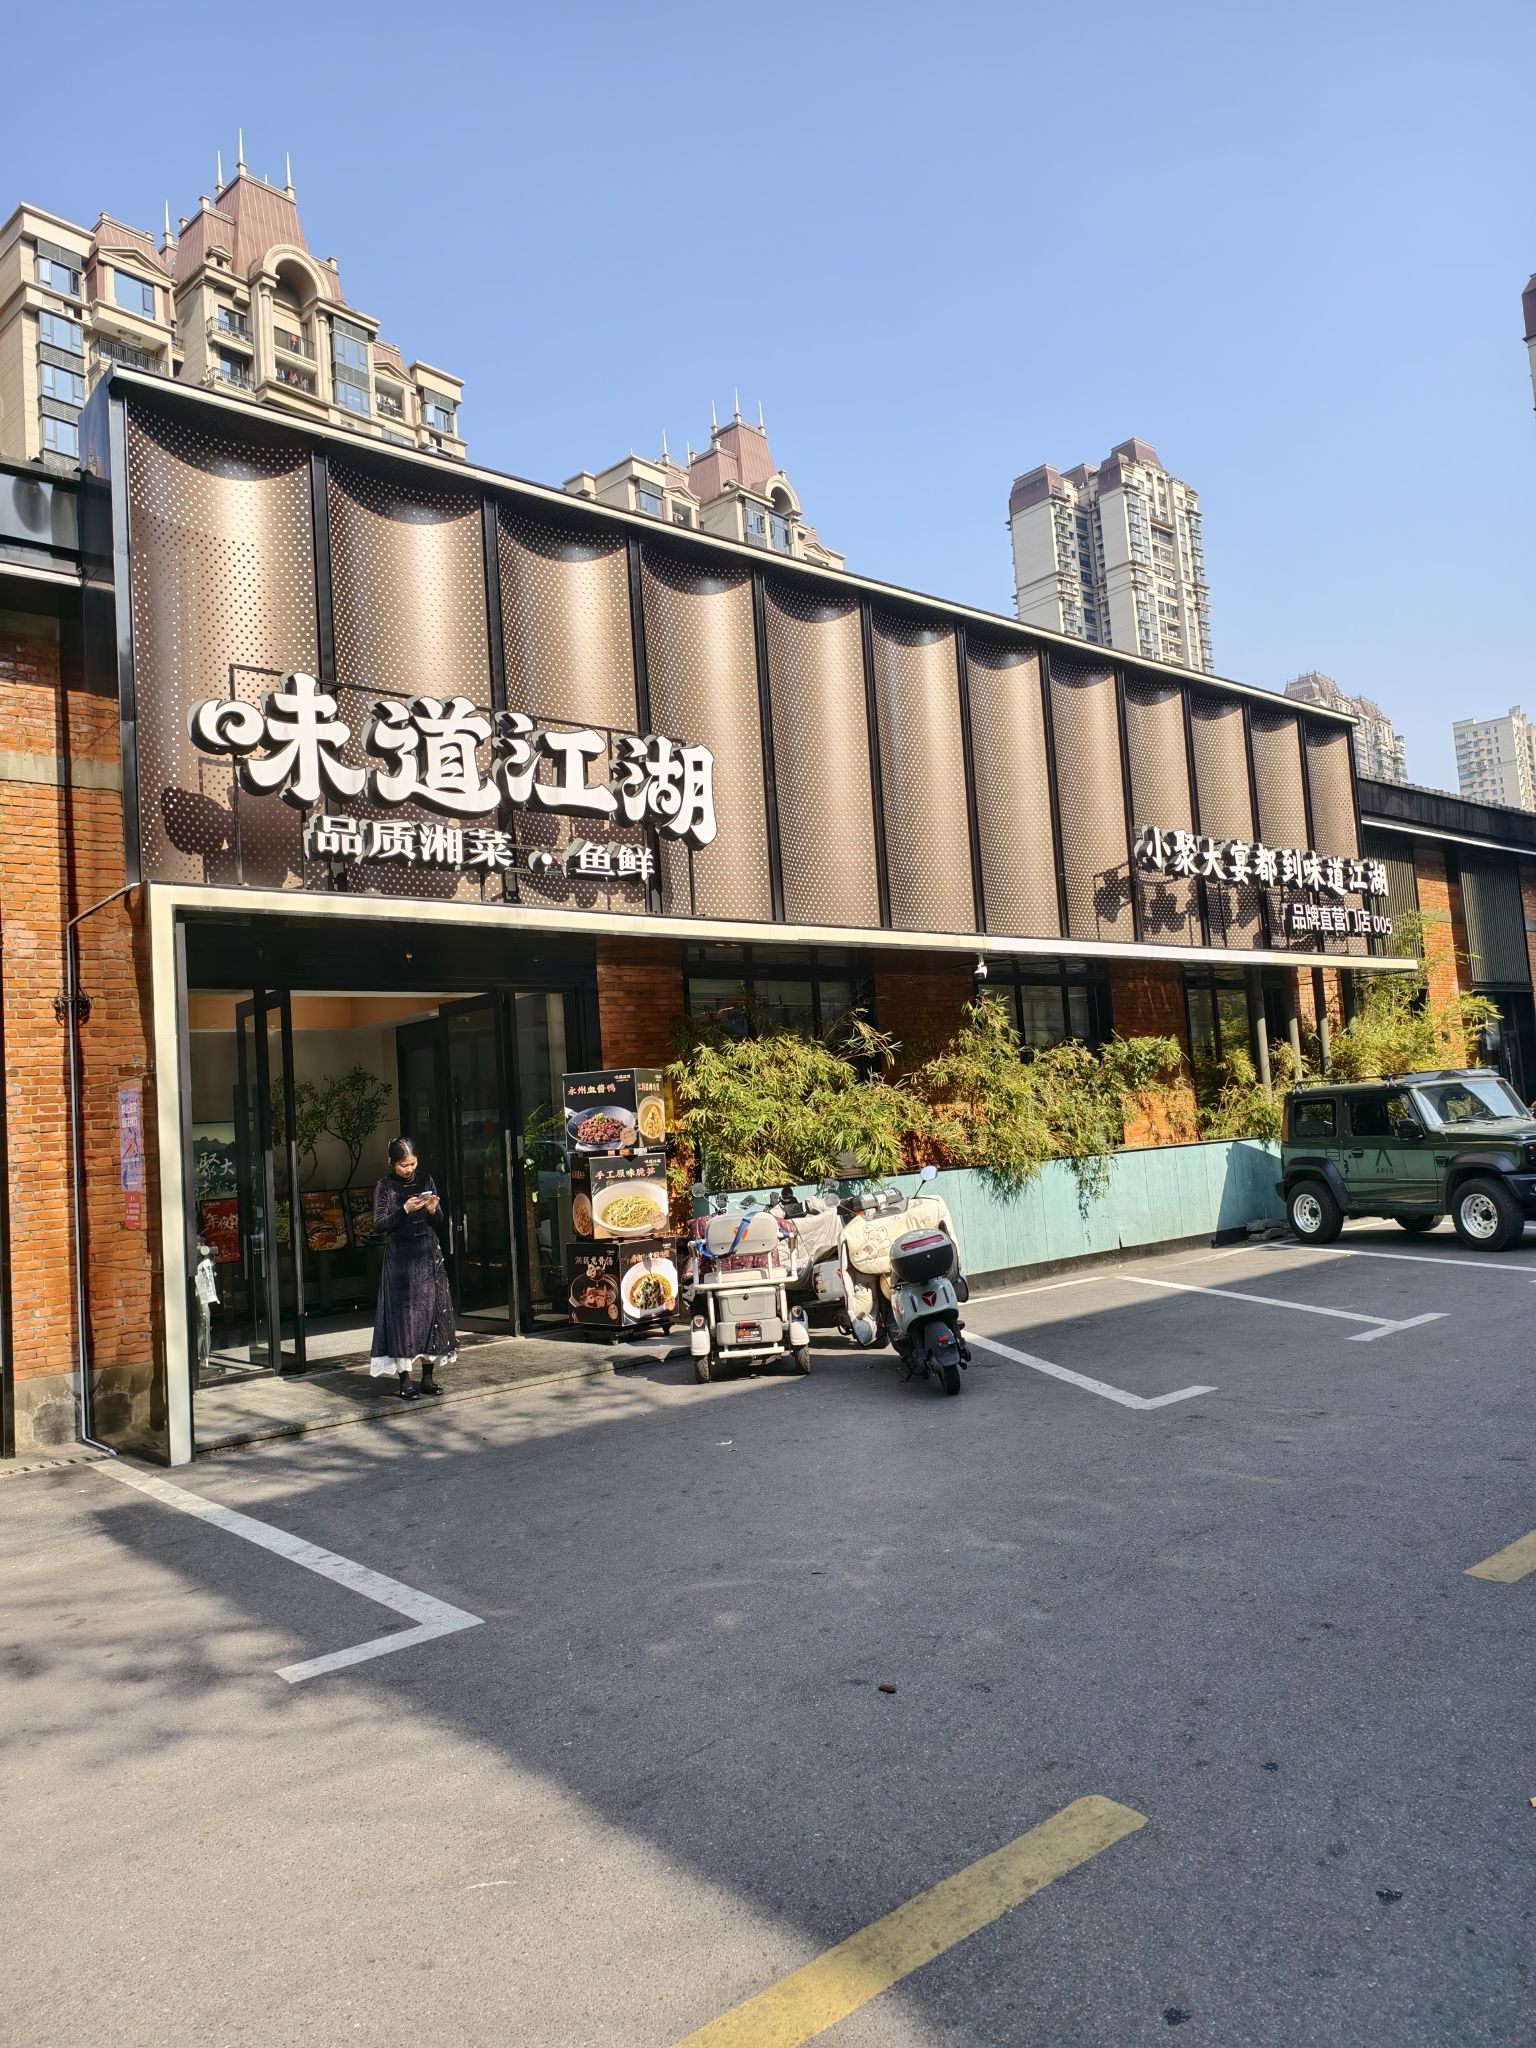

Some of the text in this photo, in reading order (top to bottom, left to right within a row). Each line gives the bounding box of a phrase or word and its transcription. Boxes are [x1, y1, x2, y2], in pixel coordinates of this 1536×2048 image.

[193, 671, 718, 845] 味道江湖
[1145, 825, 1389, 897] 小聚大宴都到味道江湖
